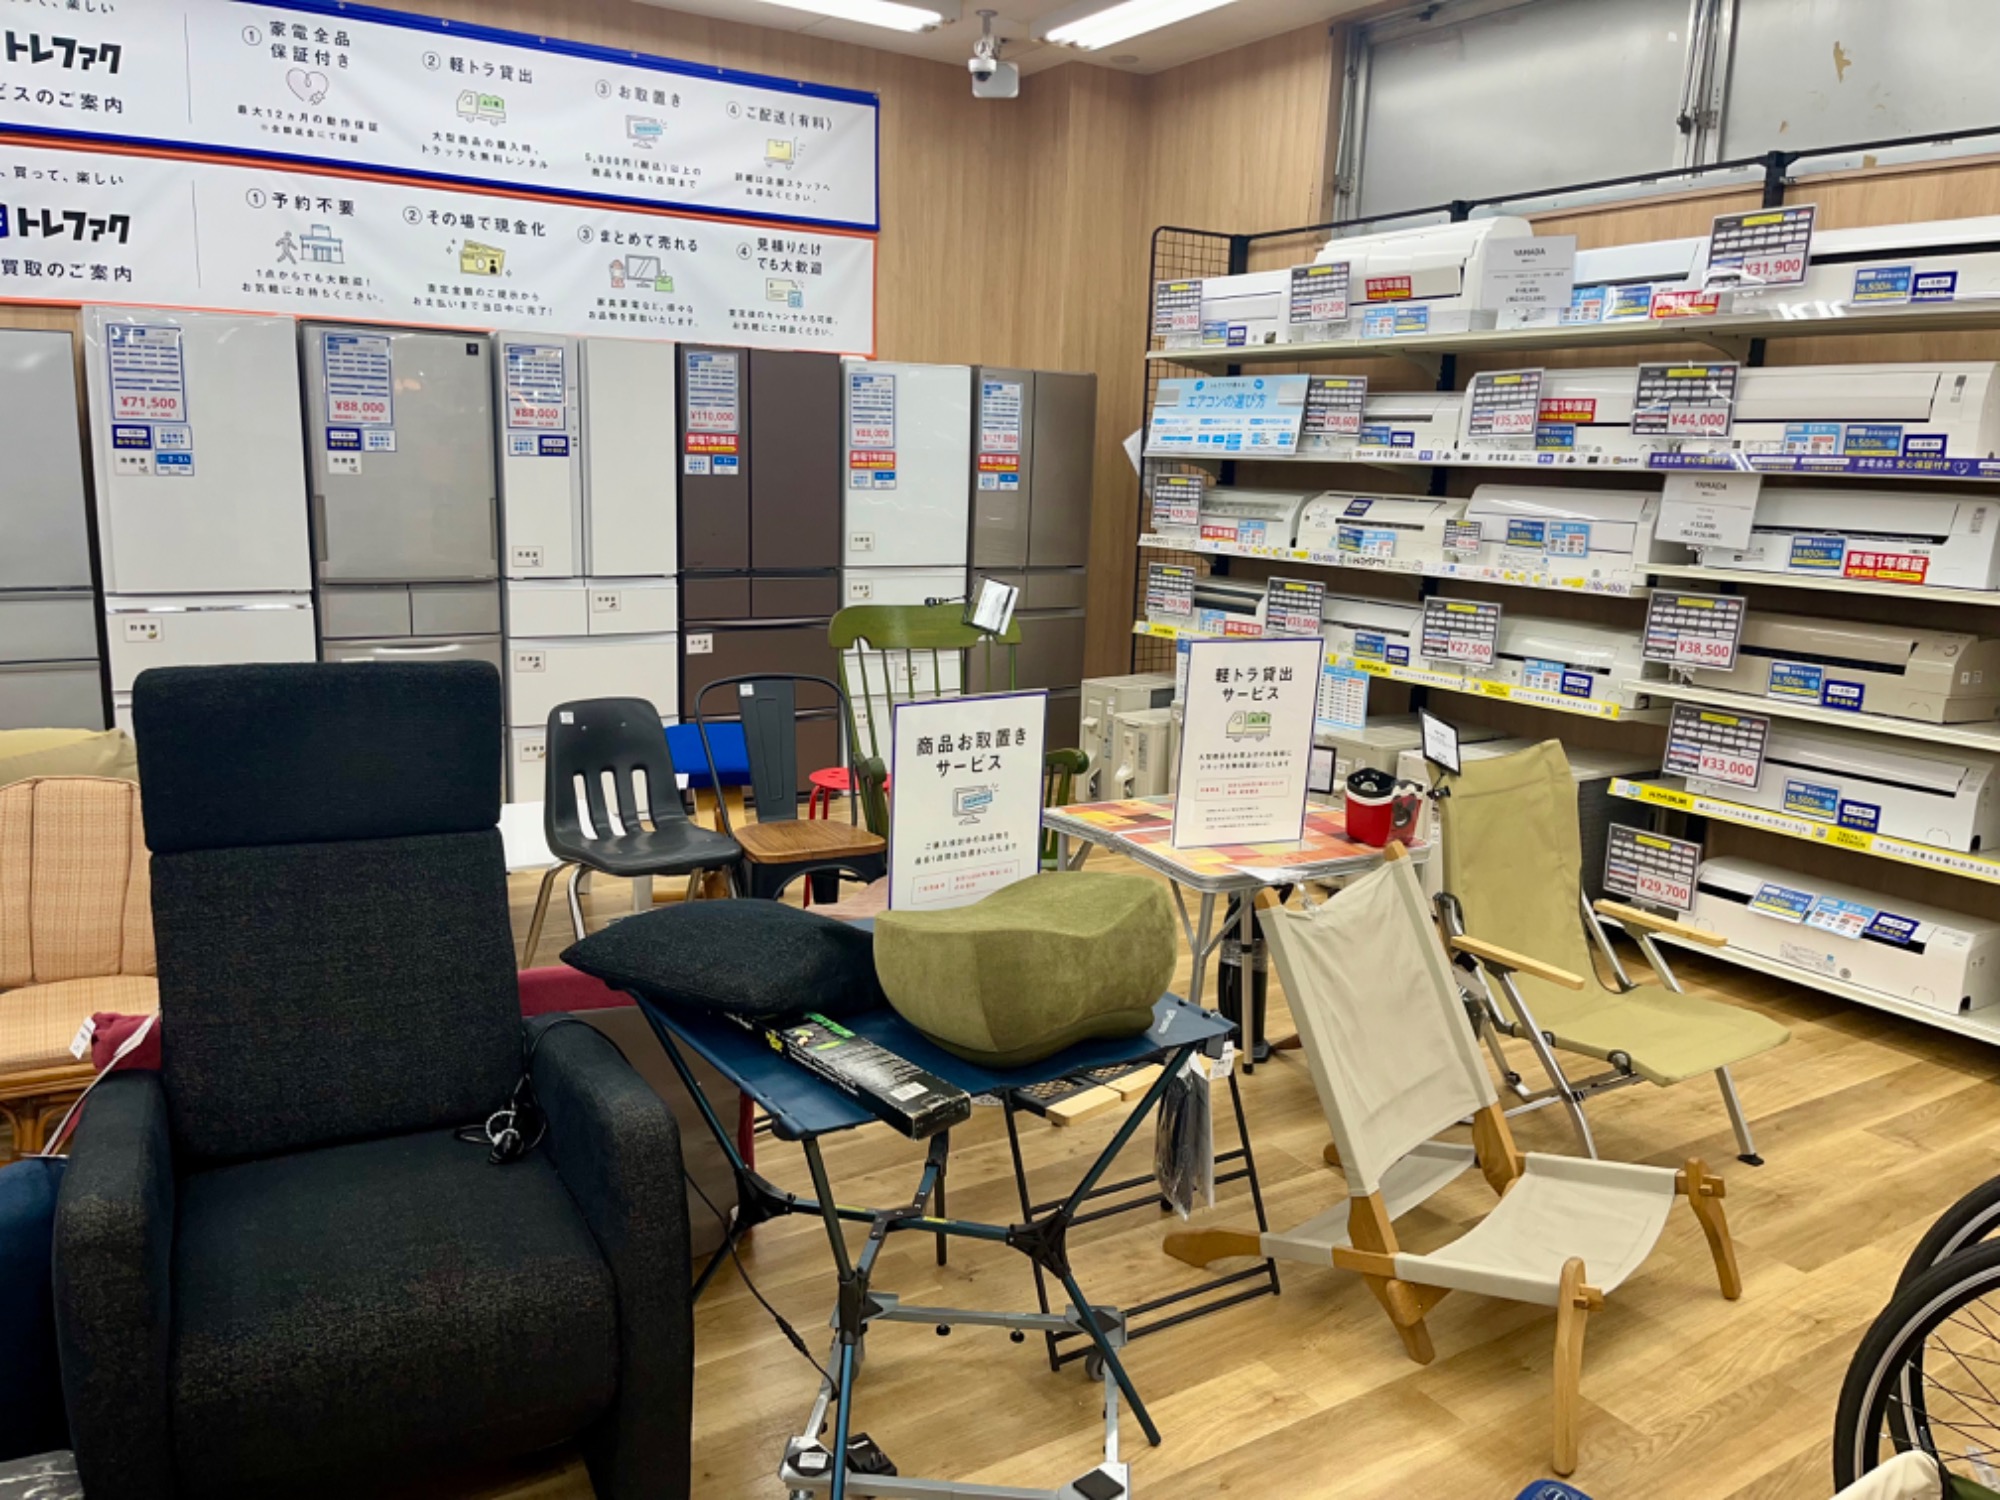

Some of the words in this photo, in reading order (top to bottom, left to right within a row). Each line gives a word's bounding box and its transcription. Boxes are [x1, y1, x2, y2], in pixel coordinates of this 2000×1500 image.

[269, 21, 350, 47] 家電全品
[5, 30, 122, 74] トレファク
[270, 42, 350, 69] 保証付き
[449, 56, 534, 86] 軽トラ貸出
[618, 84, 681, 108] お取置き
[272, 191, 355, 217] 予約不要
[18, 207, 130, 244] トレファク
[426, 211, 547, 238] その場で現金化
[600, 228, 698, 253] まとめて売れる
[756, 237, 822, 257] 見積りだけ
[1, 260, 132, 283] 買取のご案内
[757, 255, 823, 276] でも大歓迎
[1745, 259, 1800, 276] ¥31,900
[120, 396, 177, 410] ¥71,500
[335, 401, 386, 414] ¥88,000
[1671, 413, 1726, 425] ¥44,000
[1450, 641, 1491, 657] ¥27,500
[1679, 641, 1730, 659] ¥38,500
[1215, 666, 1293, 684] 軽トラ貸出
[1222, 685, 1279, 703] サービス
[916, 727, 1027, 757] 商品お取置き
[936, 754, 1002, 778] サービス
[1702, 755, 1755, 778] ¥33,000
[1639, 877, 1689, 901] ¥29,700
